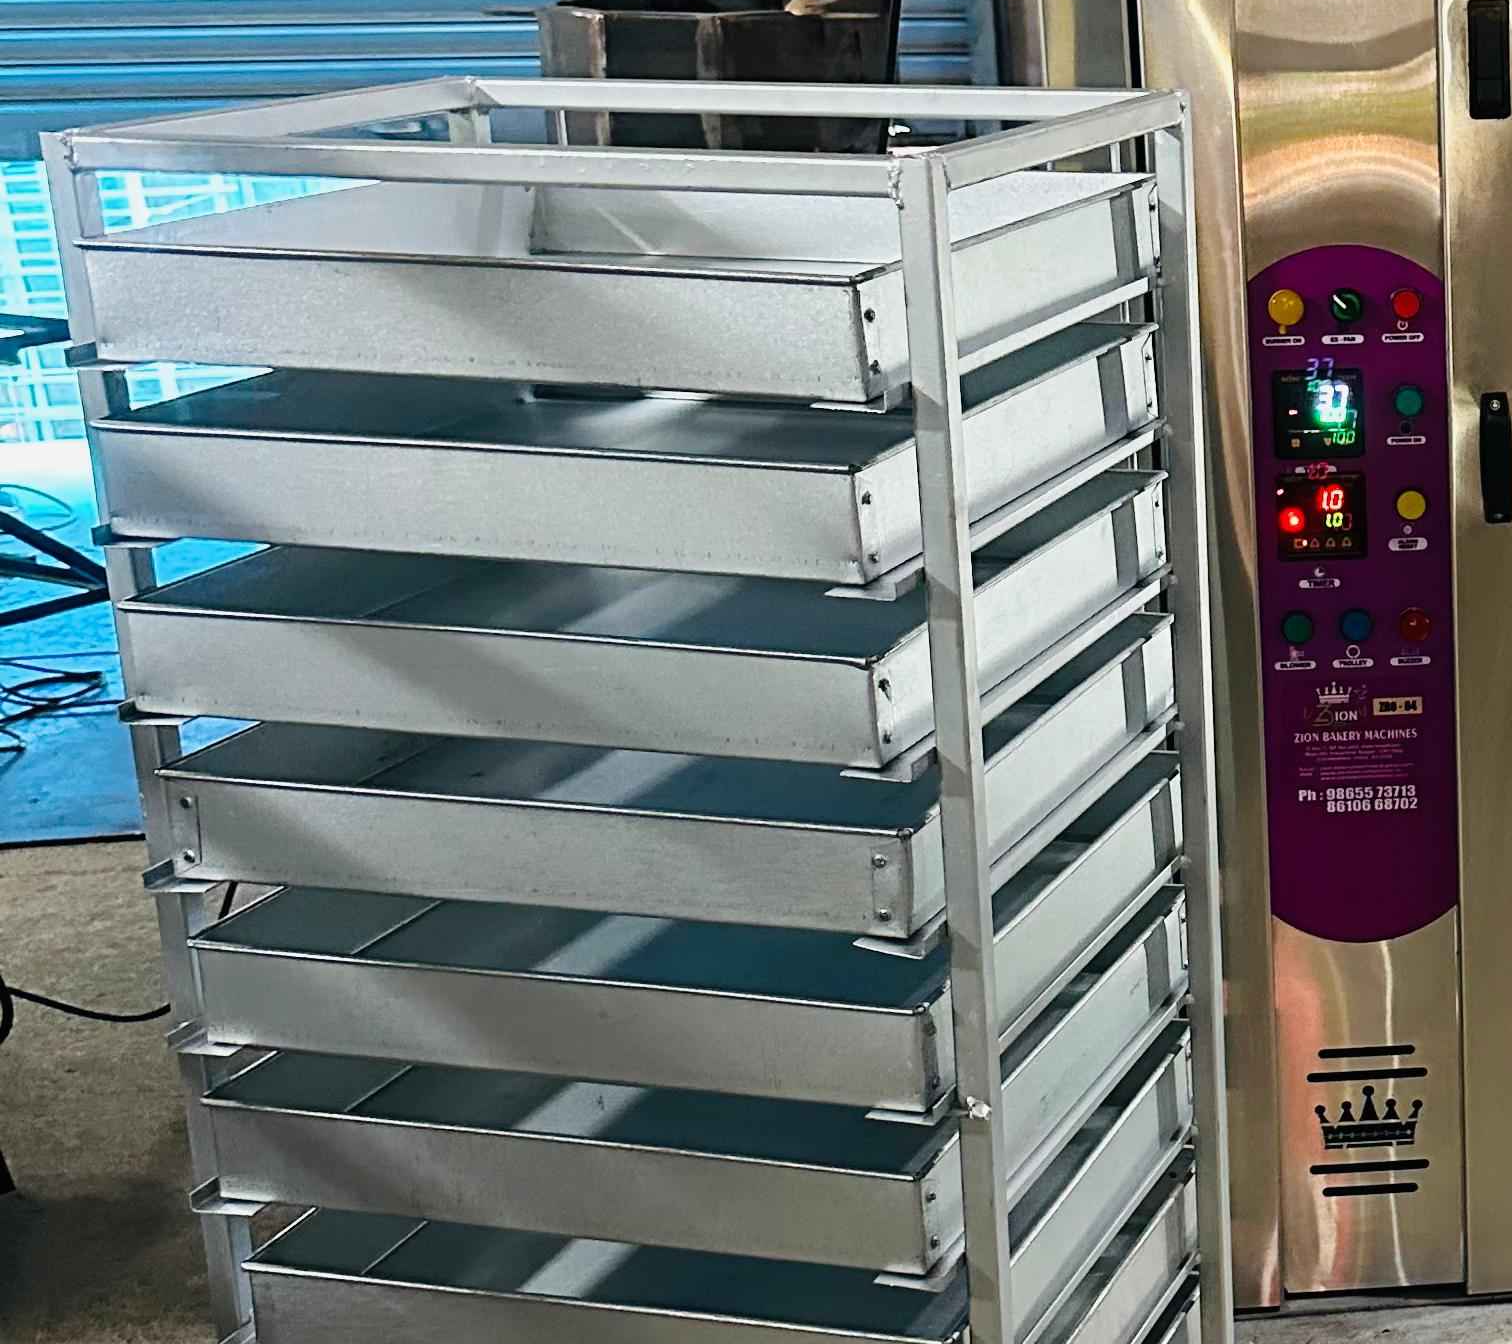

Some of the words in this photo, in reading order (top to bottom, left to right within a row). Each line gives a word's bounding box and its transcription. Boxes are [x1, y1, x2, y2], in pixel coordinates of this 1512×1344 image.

[1293, 732, 1319, 744] ZION
[1322, 730, 1361, 742] BAKERY
[1364, 728, 1418, 740] MACHINES
[1298, 789, 1316, 801] Ph
[1326, 786, 1374, 801] 98655
[1377, 784, 1416, 798] 73713
[1326, 799, 1372, 813] 86106
[1374, 797, 1418, 811] 68702
